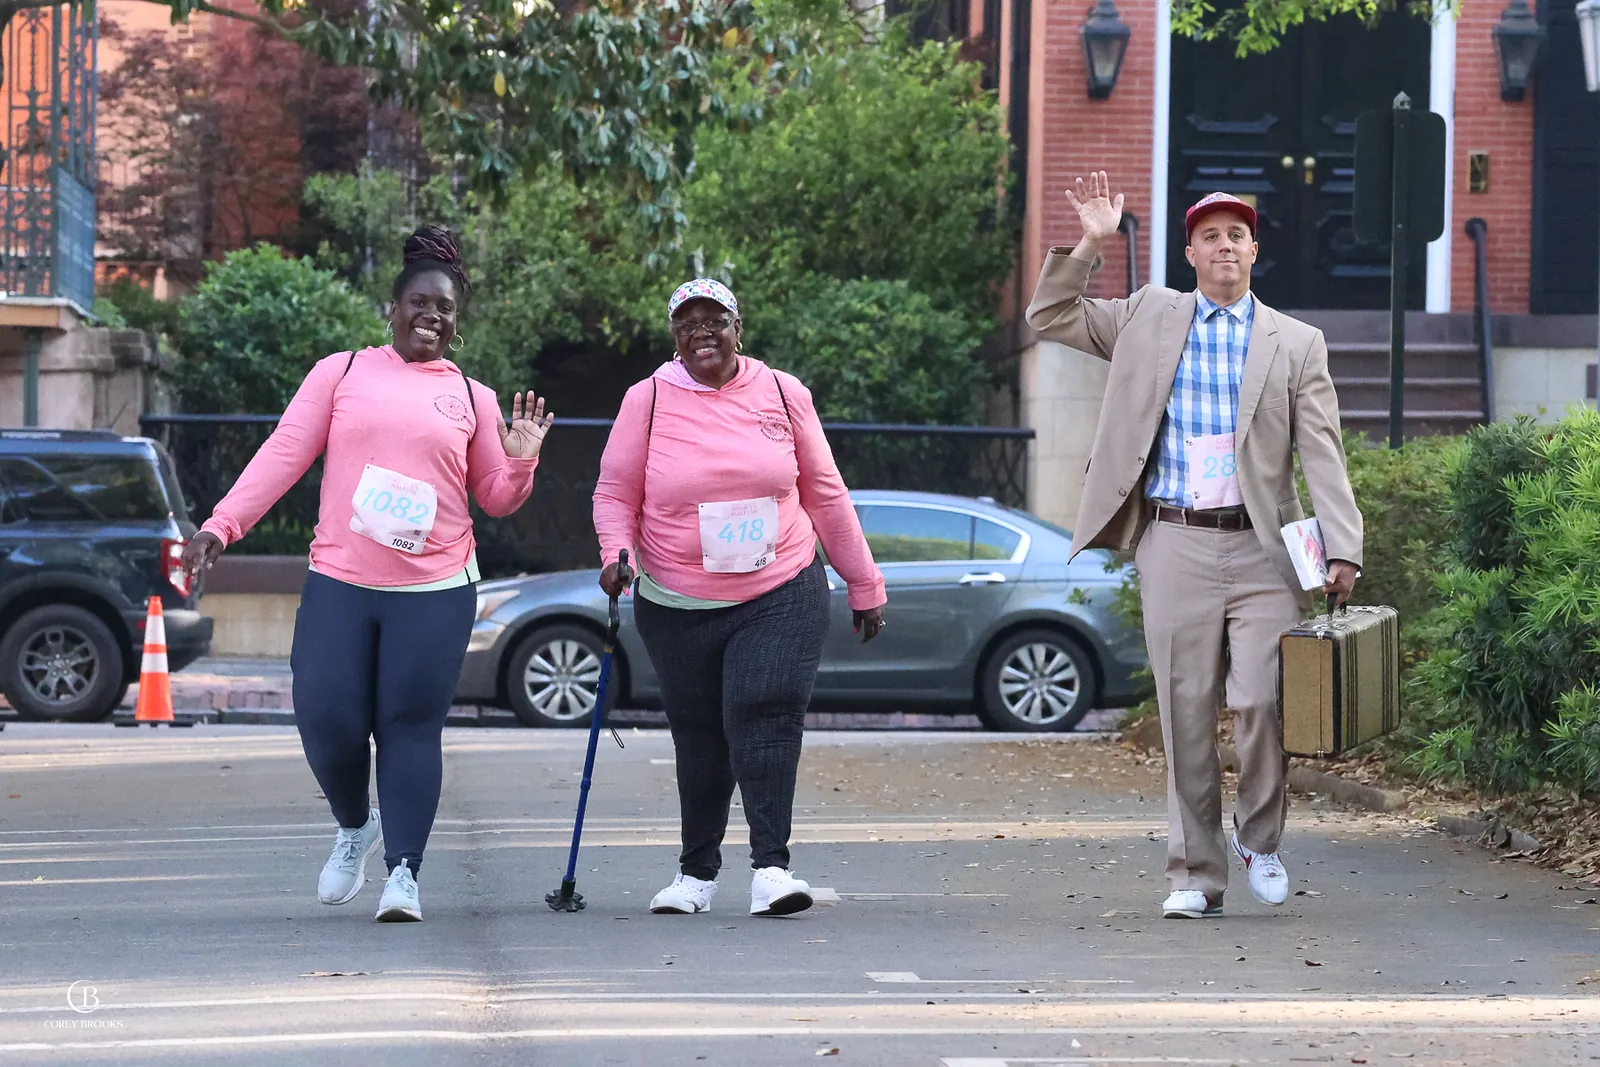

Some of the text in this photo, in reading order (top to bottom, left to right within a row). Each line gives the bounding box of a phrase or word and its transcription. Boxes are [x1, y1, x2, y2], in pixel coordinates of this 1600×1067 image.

[1202, 453, 1236, 478] 28
[361, 487, 430, 525] 1082
[717, 518, 765, 543] 418
[392, 538, 415, 550] 1082
[755, 557, 767, 567] 418
